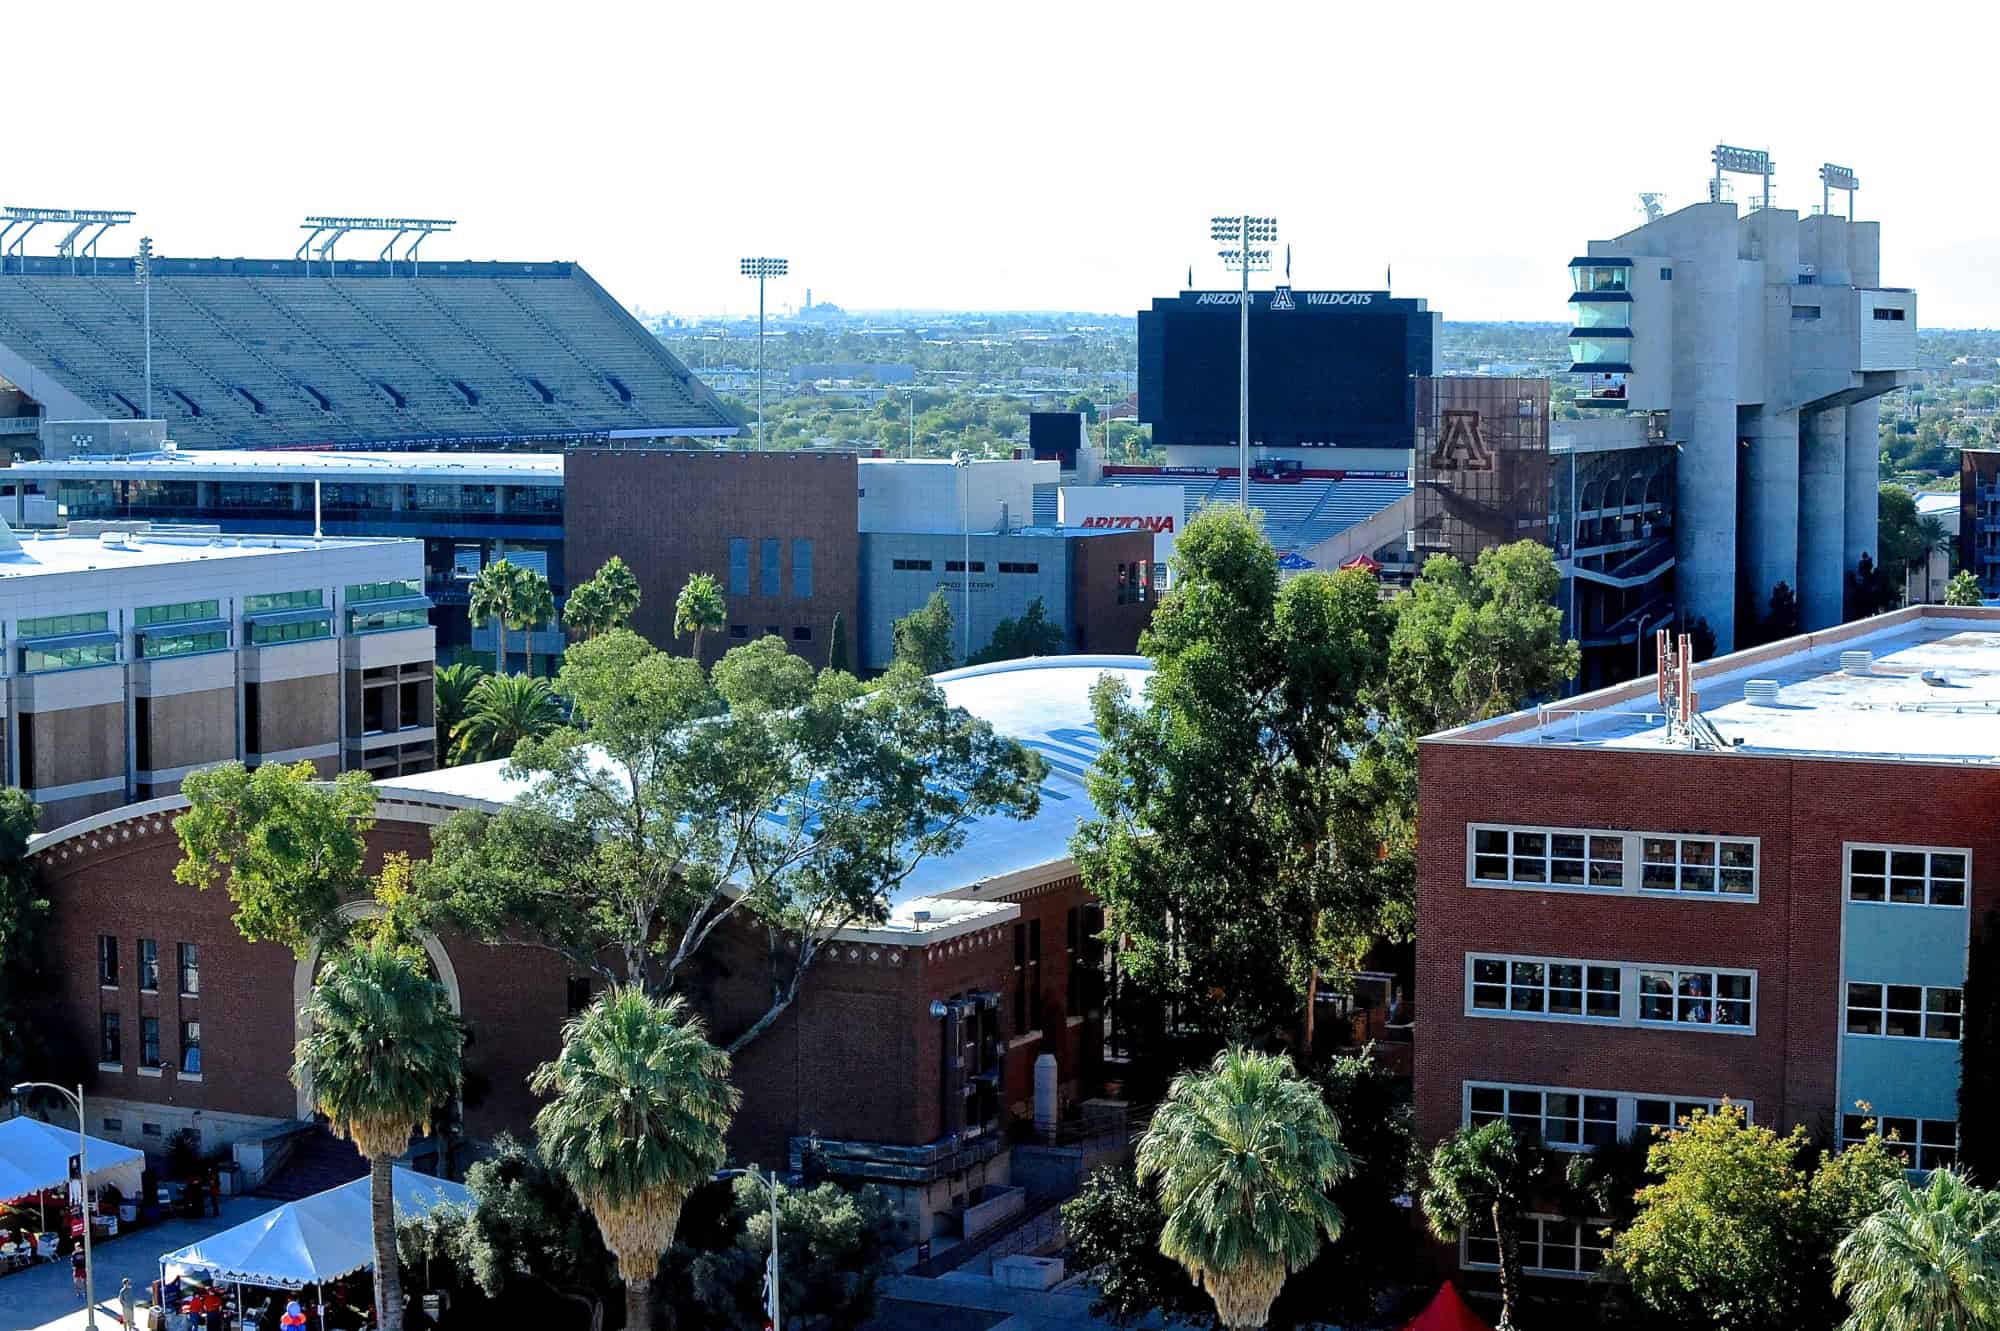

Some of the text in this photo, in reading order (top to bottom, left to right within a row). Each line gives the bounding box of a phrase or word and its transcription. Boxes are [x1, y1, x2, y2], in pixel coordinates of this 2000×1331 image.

[1196, 293, 1254, 305] ARIZONA
[1306, 293, 1373, 305] WILDCATS
[1431, 410, 1495, 472] A
